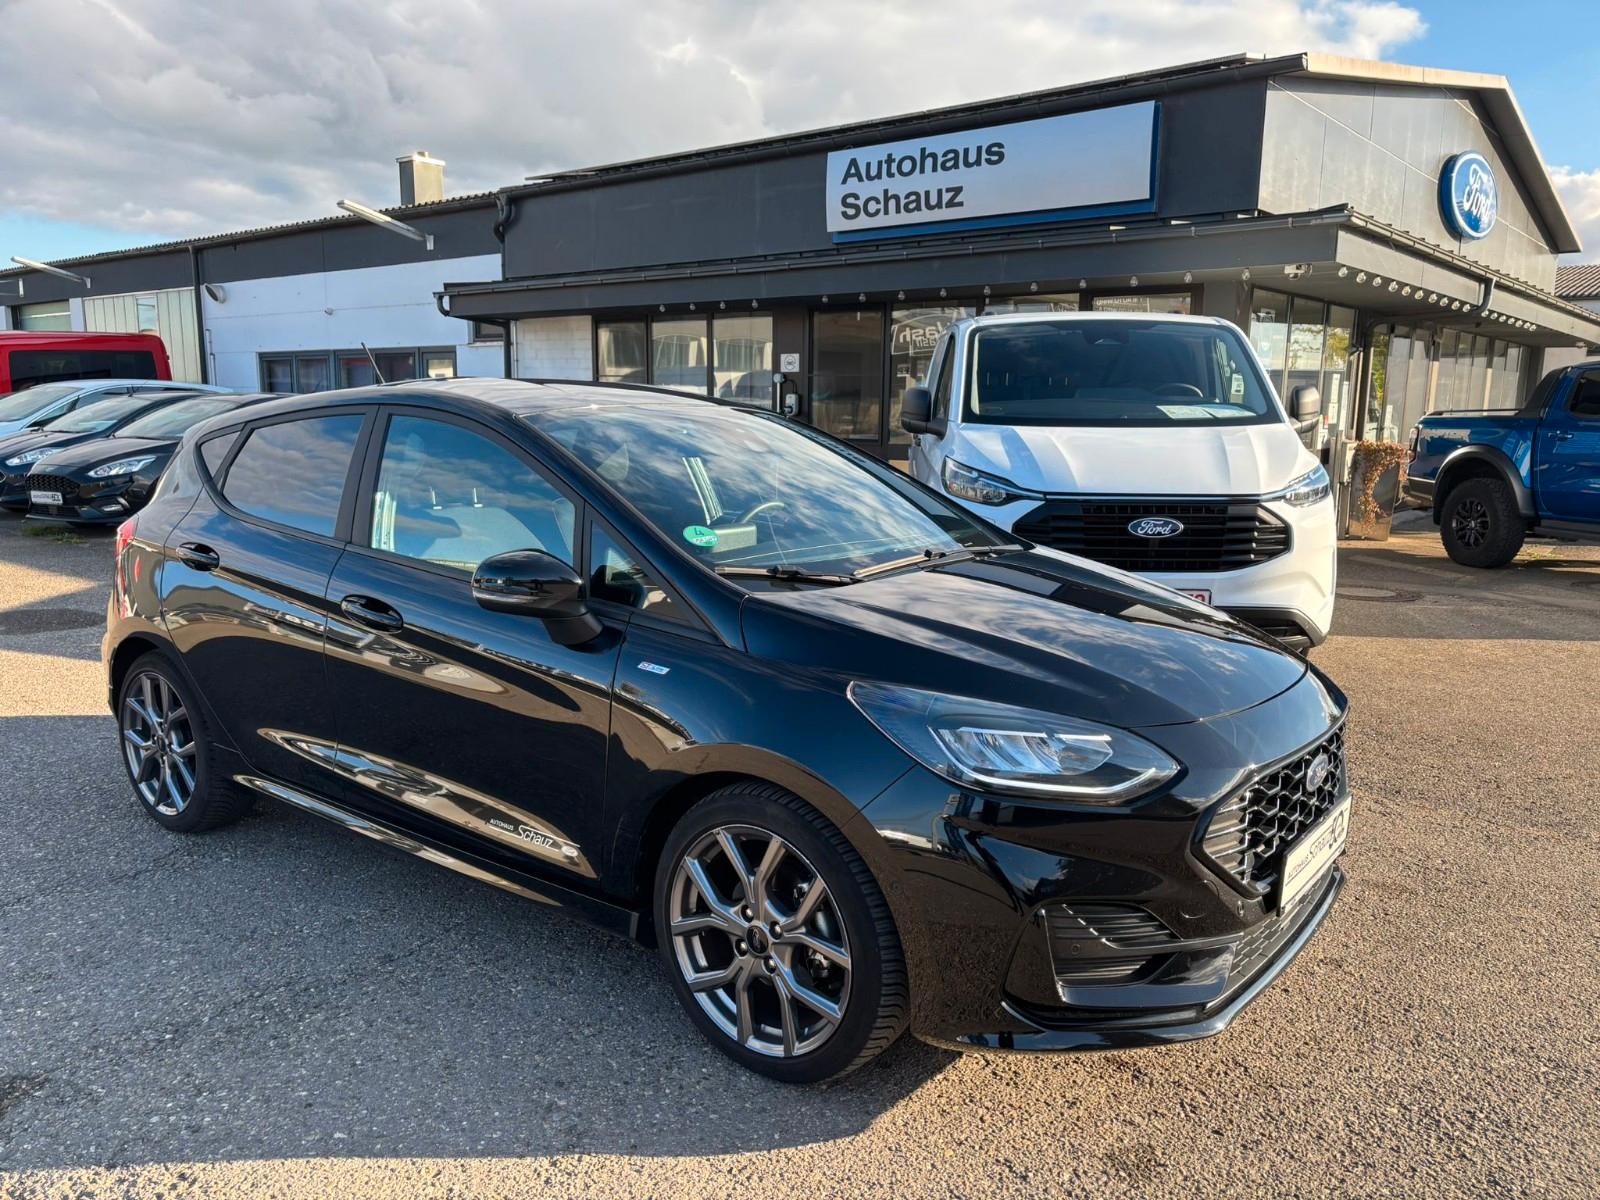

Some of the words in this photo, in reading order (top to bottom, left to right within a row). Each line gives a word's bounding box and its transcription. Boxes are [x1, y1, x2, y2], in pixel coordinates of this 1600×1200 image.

[840, 142, 1006, 185] Autohaus
[840, 185, 964, 220] Schauz
[1463, 163, 1493, 222] Ford
[1137, 520, 1172, 535] Ford
[489, 818, 514, 831] AUTOHAUS
[518, 825, 554, 849] Schauz
